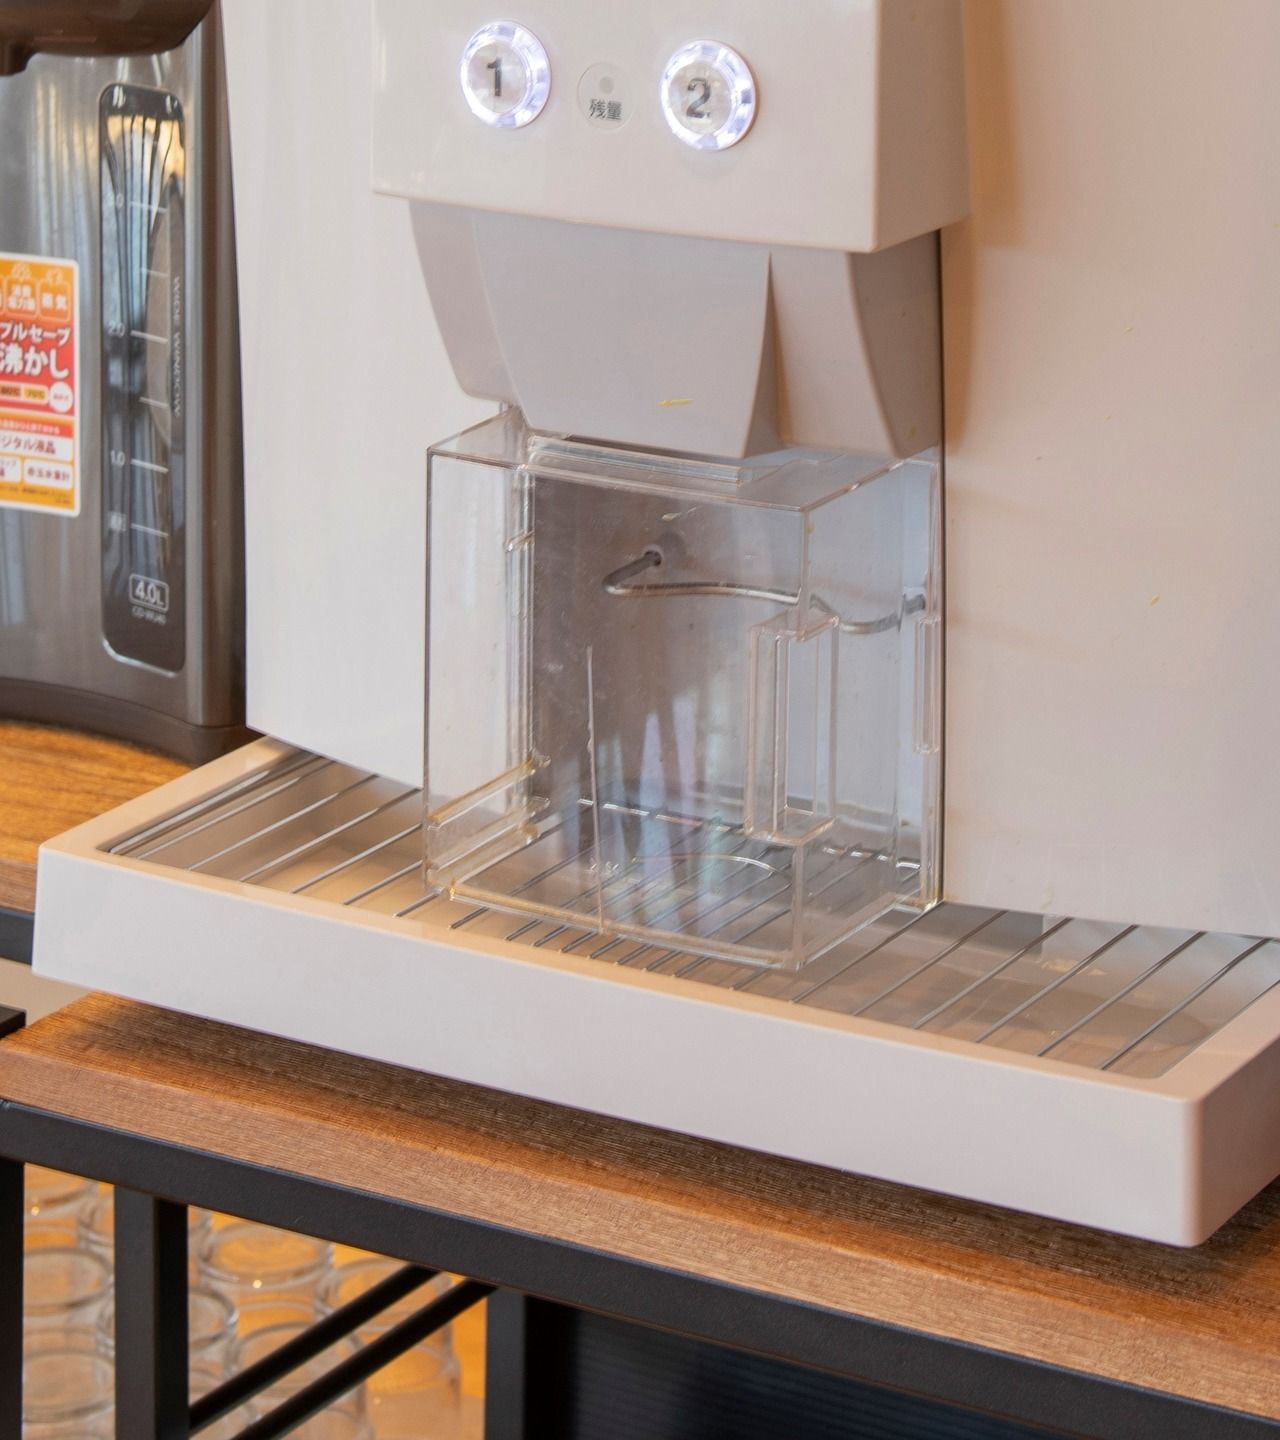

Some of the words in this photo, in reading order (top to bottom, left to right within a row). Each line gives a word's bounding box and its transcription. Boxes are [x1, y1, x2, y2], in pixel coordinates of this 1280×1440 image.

[487, 58, 503, 98] 1
[589, 97, 623, 121] 残量
[686, 78, 711, 119] 2
[134, 580, 166, 607] 4.0L
